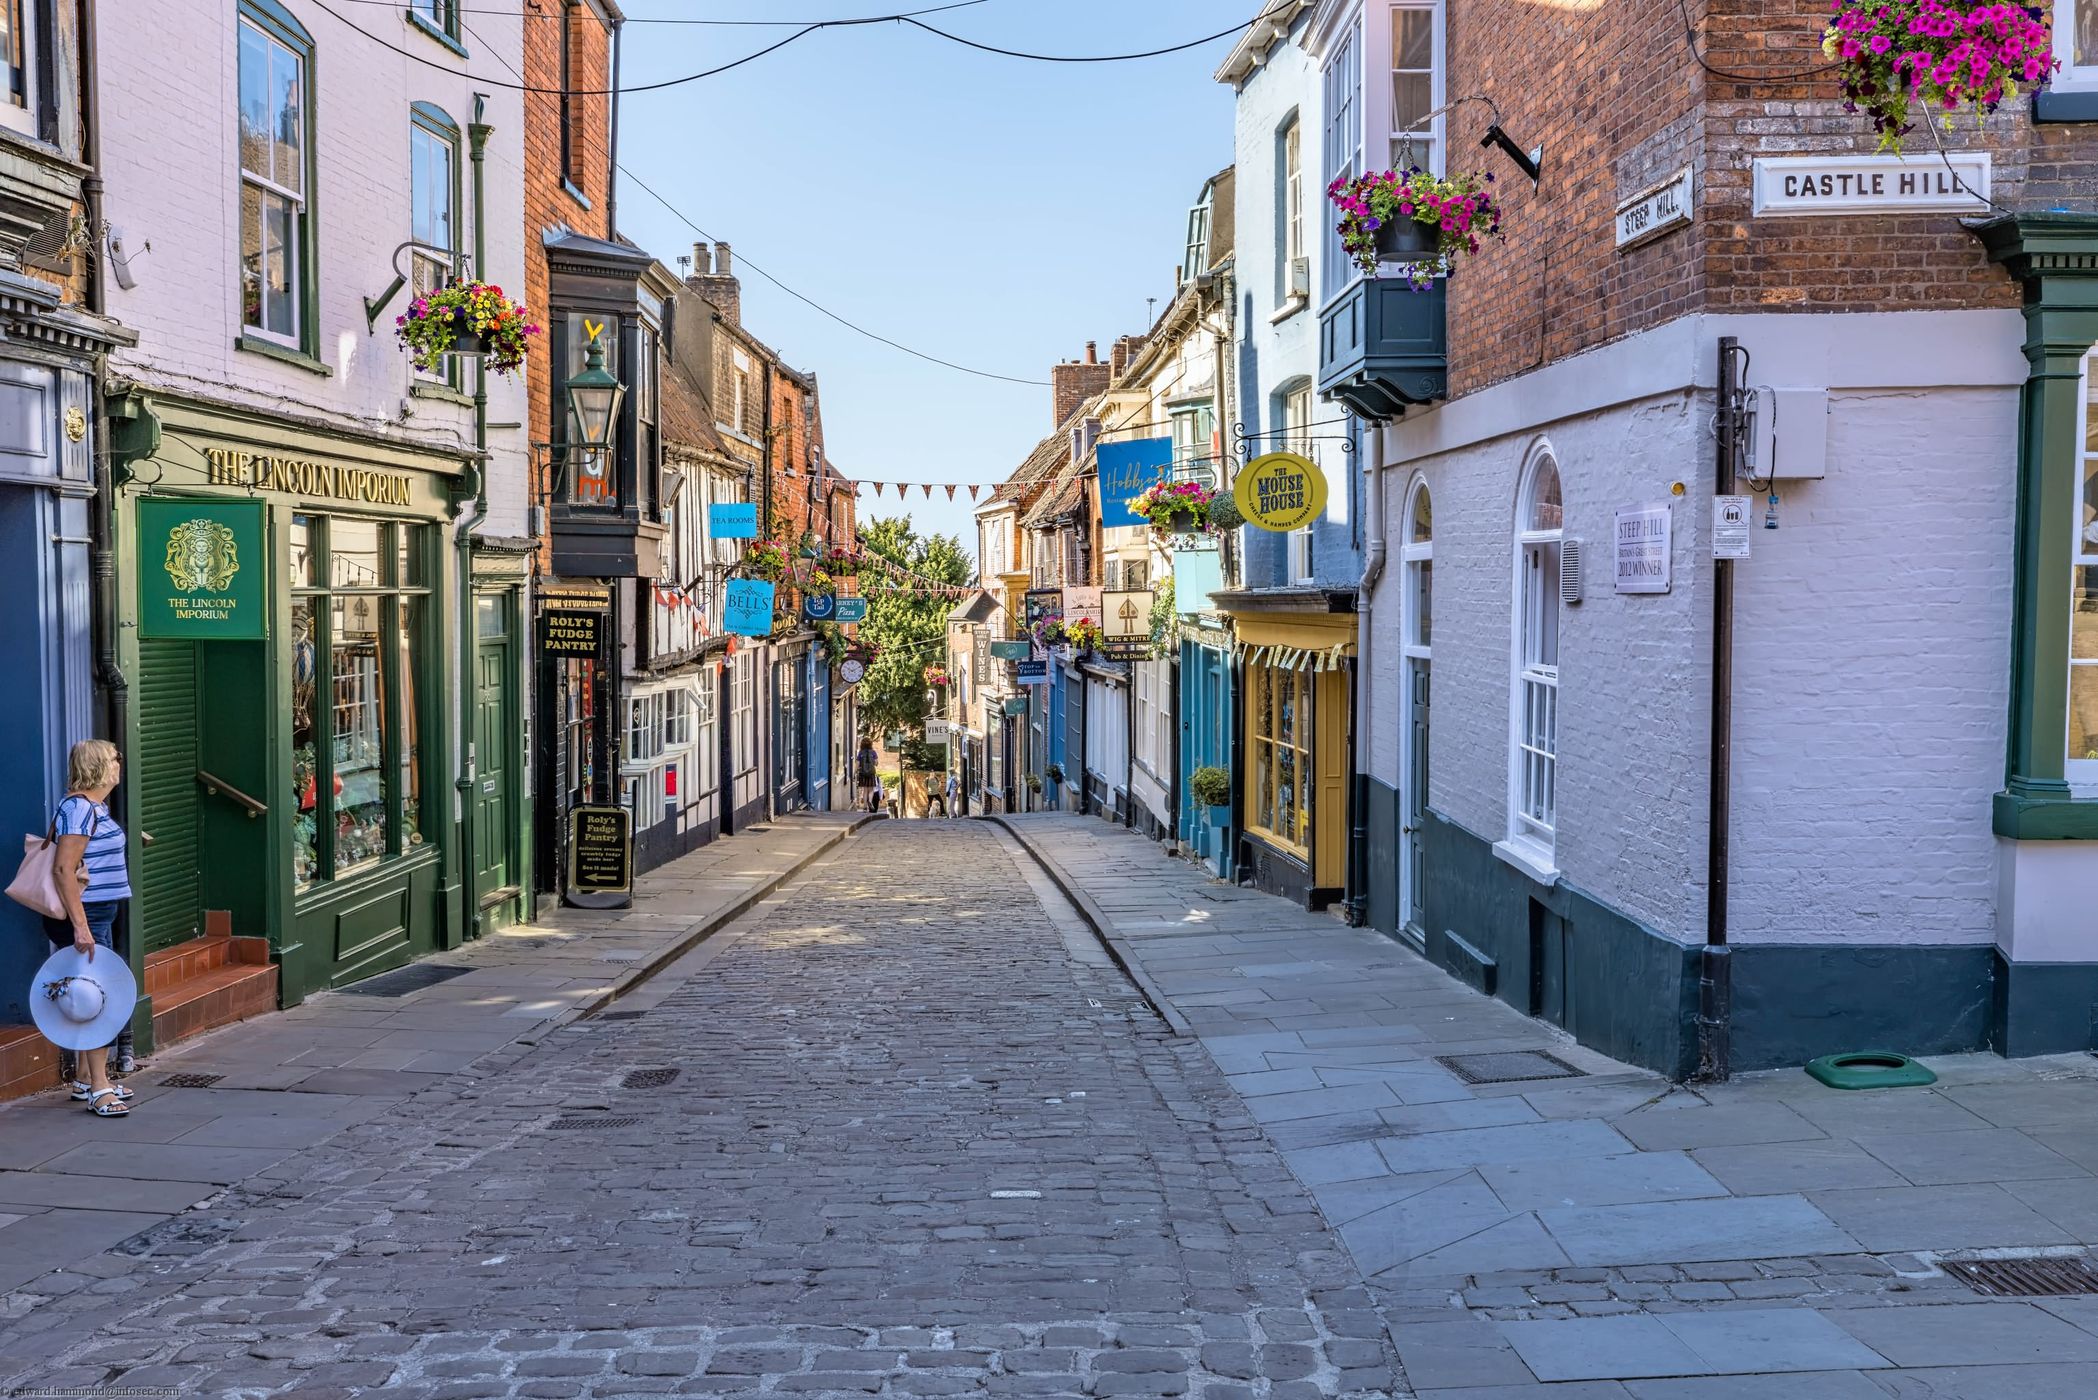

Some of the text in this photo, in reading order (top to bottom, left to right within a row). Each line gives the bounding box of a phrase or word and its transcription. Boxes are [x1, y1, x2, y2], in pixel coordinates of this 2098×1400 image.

[1785, 173, 1884, 197] CASTLE
[1625, 203, 1649, 235] STEEP
[207, 448, 413, 505] THE LINCOLN IMPORIUM
[1273, 467, 1287, 476] THE
[1257, 473, 1303, 496] MOUSE
[1260, 491, 1303, 514] HOUSE
[1248, 502, 1263, 521] CHEESE
[1292, 503, 1312, 524] COMPANY
[1619, 519, 1664, 539] STEEP HILL
[1619, 560, 1663, 576] 2012 WINNER
[168, 598, 236, 608] THE LINCOLN
[176, 610, 229, 619] IMPORIUM
[549, 617, 594, 627] ROLY'S
[549, 629, 594, 639] FUDGE
[545, 640, 597, 651] PANTRY
[976, 641, 988, 682] WINES
[927, 726, 949, 734] VINE'S
[587, 815, 616, 824] Roly's
[587, 825, 616, 834] Fudge
[585, 833, 618, 843] Pantry
